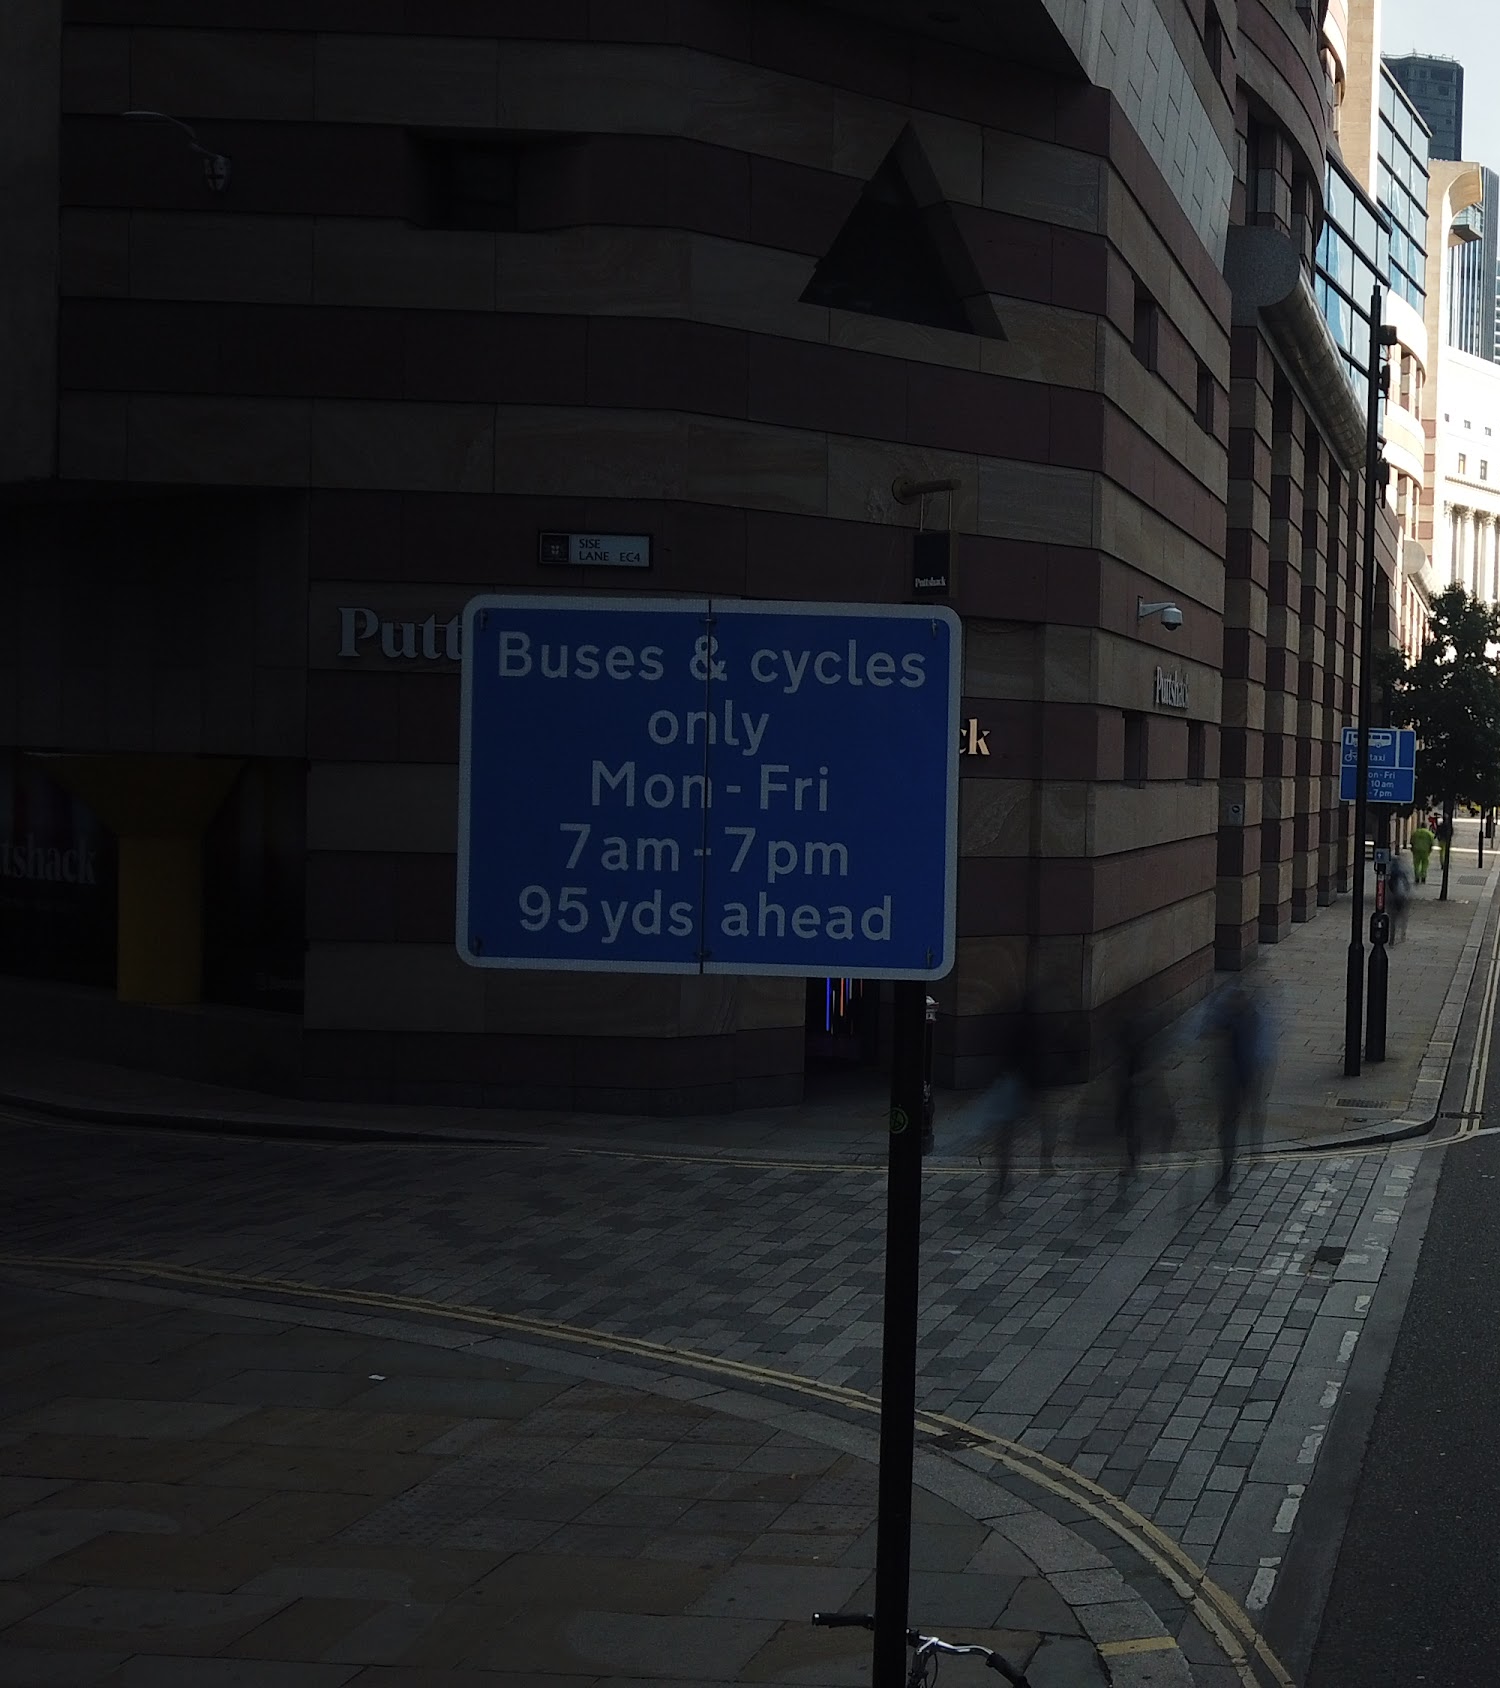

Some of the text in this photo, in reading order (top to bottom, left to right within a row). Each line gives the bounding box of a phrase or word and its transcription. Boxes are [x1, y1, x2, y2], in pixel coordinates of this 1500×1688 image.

[579, 539, 600, 549] SISE
[579, 551, 640, 562] LANE EC4
[337, 607, 462, 661] Putt
[498, 631, 927, 694] Buses & cycles
[647, 699, 770, 757] only
[1369, 753, 1386, 762] taxi
[1370, 779, 1394, 788] 10am
[0, 832, 97, 886] tshack
[720, 892, 893, 941] ahead
